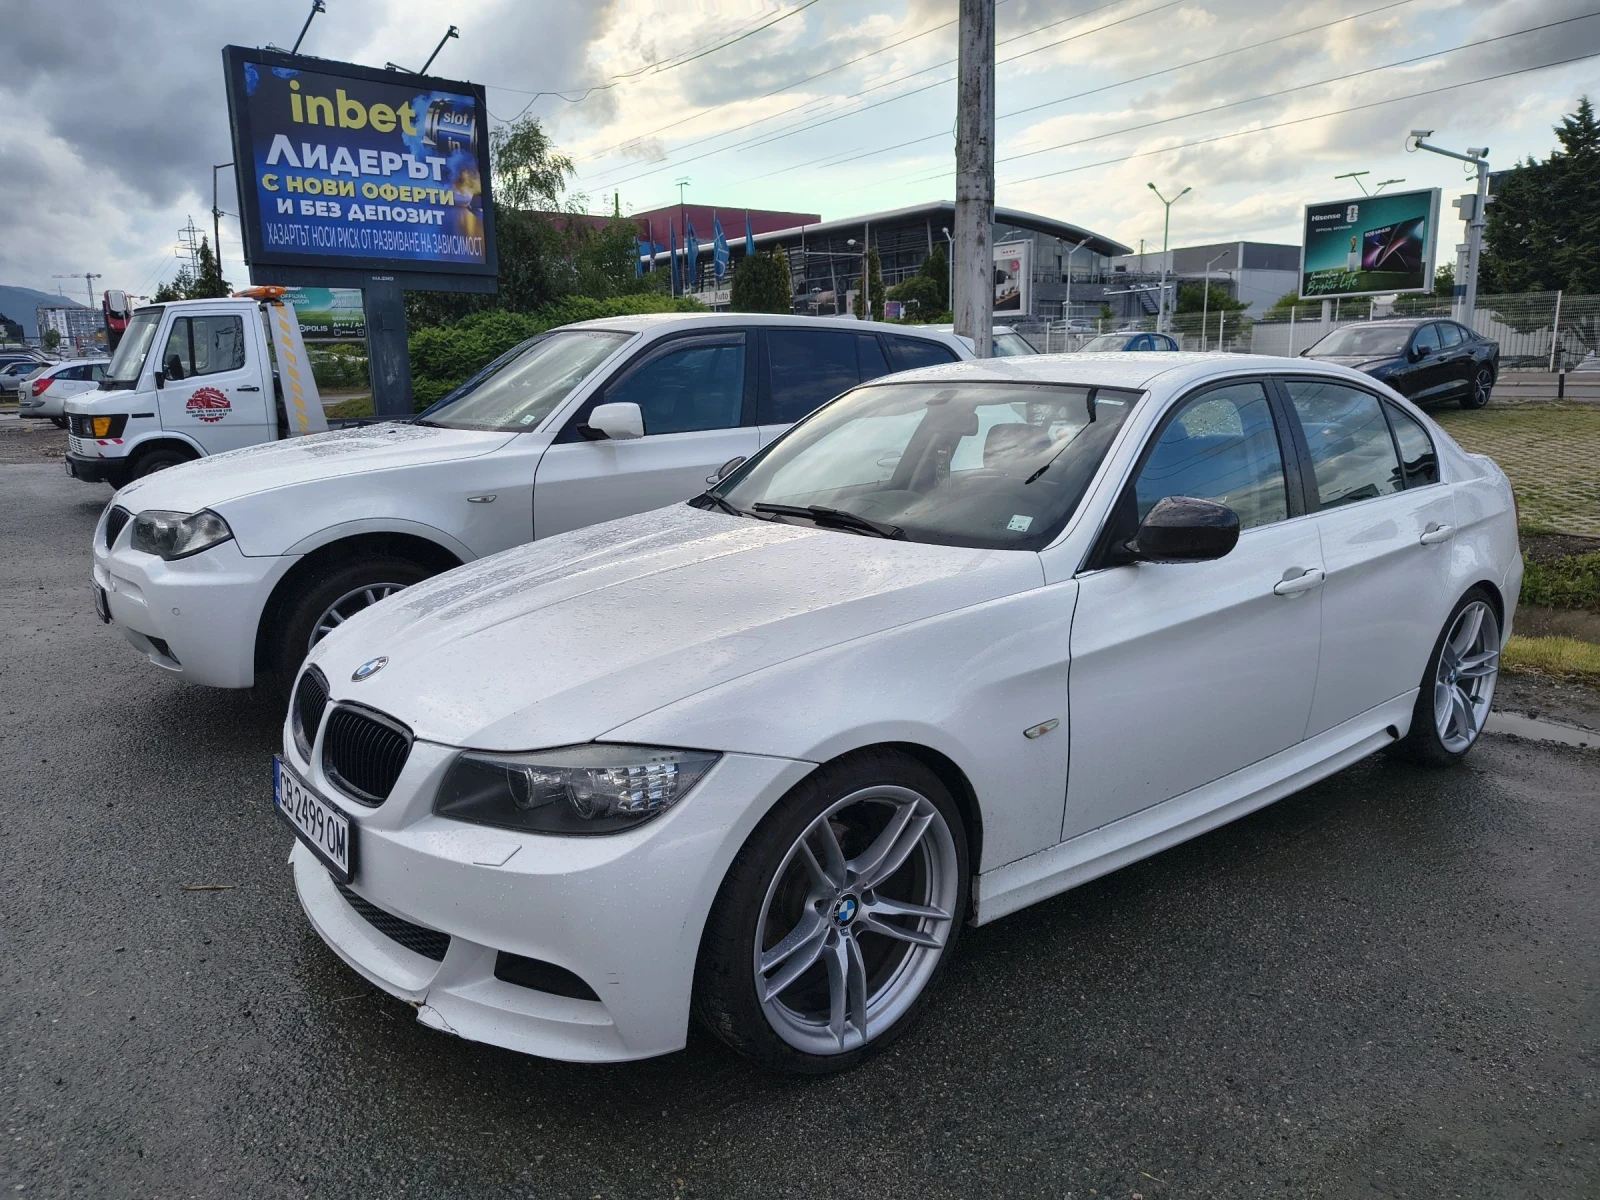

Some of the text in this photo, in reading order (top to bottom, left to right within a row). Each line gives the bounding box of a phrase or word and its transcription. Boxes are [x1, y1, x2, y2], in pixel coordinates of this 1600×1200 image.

[289, 80, 417, 136] inbet
[443, 110, 469, 127] slot
[265, 134, 446, 181] ЛИДЕРЪТ
[261, 173, 454, 206] С НОВИ ОФЕРТИ
[277, 198, 445, 226] И БЕЗ ДЕПОЗИТ
[1311, 213, 1341, 222] Hisense
[267, 222, 483, 256] ХАЗАРТЪТ НОСИ РИСК ОТ РАЗВИВАНЕ НА ЗАВИСИМОСТ
[1306, 273, 1358, 296] Brighter Life
[280, 771, 346, 866] CB 2499 OM
